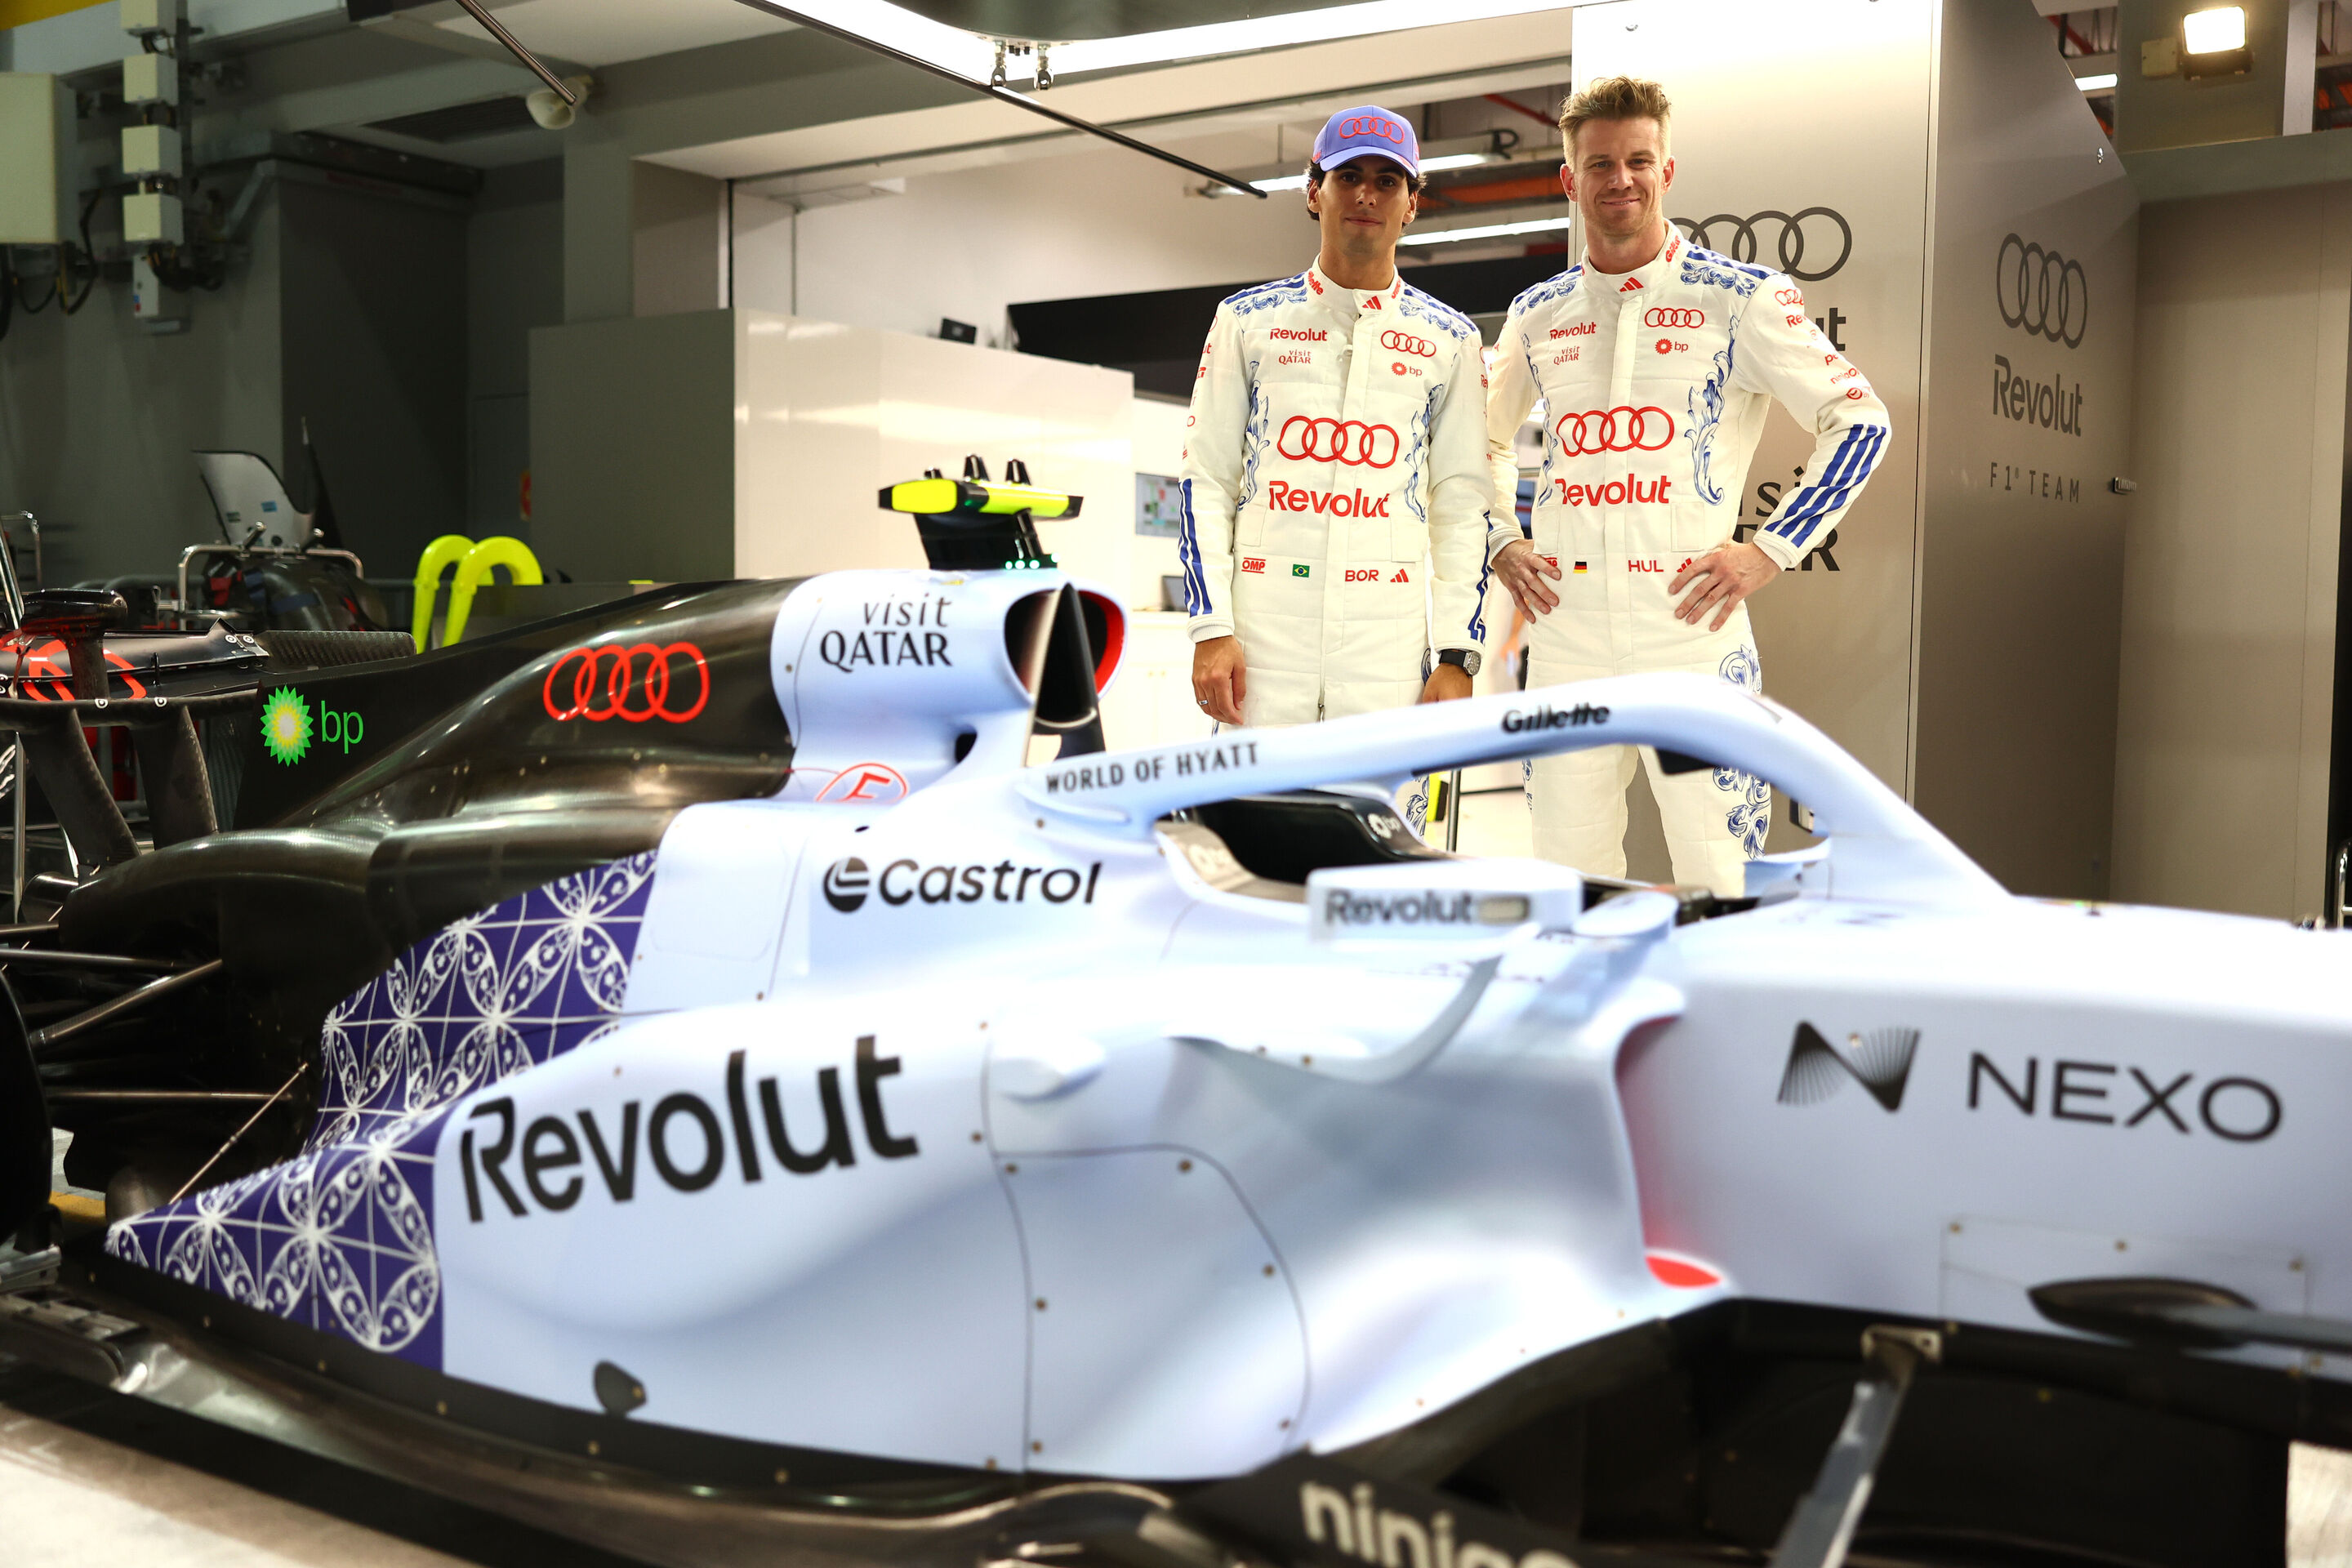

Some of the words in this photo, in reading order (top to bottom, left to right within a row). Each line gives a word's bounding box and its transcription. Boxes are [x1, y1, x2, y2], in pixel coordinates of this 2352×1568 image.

[1269, 327, 1328, 341] Revolut
[1549, 322, 1597, 341] Revolut
[1674, 341, 1689, 353] bp
[1278, 355, 1312, 365] QATAR
[1553, 353, 1579, 366] QATAR
[1561, 345, 1580, 354] visit
[1409, 367, 1423, 377] bp
[1993, 354, 2083, 437] Revolut
[1268, 480, 1390, 519] Revolut
[2029, 470, 2079, 503] TEAM
[1241, 559, 1266, 572] OMP
[1344, 569, 1379, 582] BOR
[1628, 559, 1664, 572] HUL
[862, 592, 953, 627] visit
[819, 630, 954, 674] QATAR
[320, 701, 364, 754] bp
[1502, 702, 1610, 734] Gillette
[1046, 761, 1125, 794] WORLD
[1134, 756, 1164, 782] OF
[1176, 742, 1260, 777] HYATT
[879, 857, 1102, 906] Castrol
[1324, 889, 1473, 926] Revolut
[1967, 1050, 2283, 1143] NEXO
[460, 1034, 920, 1223] Revolut
